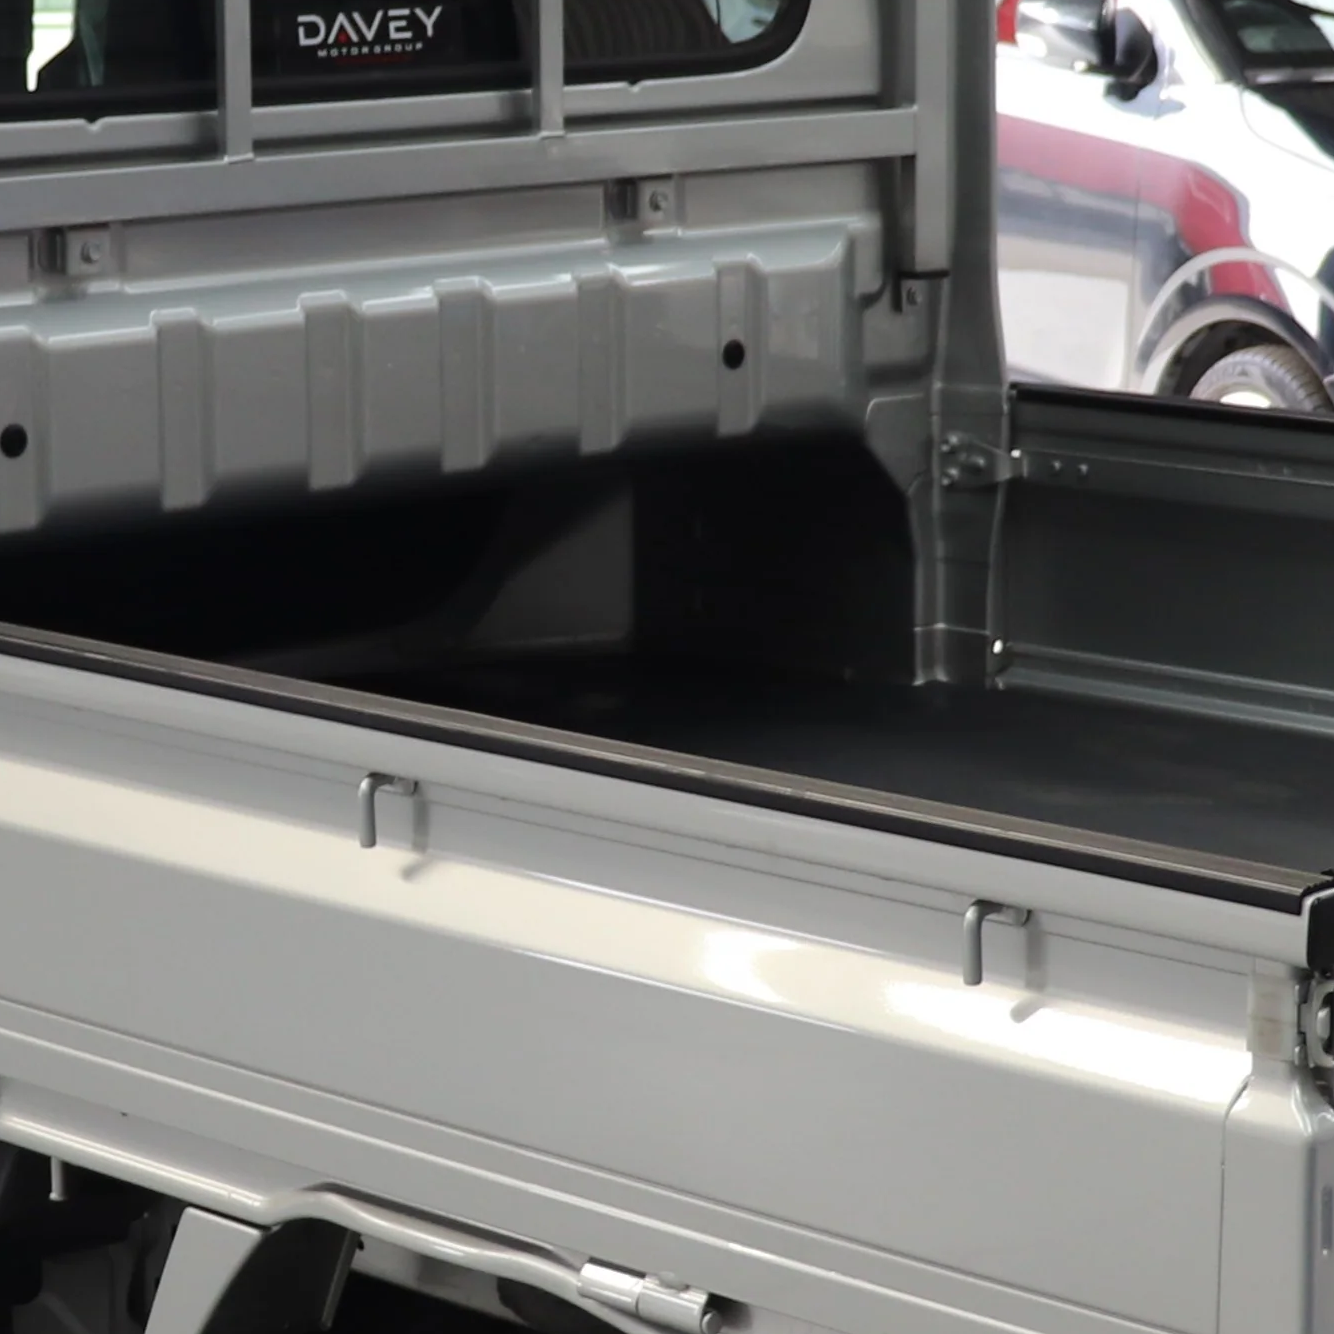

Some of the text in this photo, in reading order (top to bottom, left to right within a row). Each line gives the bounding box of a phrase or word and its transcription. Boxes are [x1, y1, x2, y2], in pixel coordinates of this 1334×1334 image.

[297, 5, 443, 47] DAVEY
[317, 42, 423, 57] MOTOR GROUP
